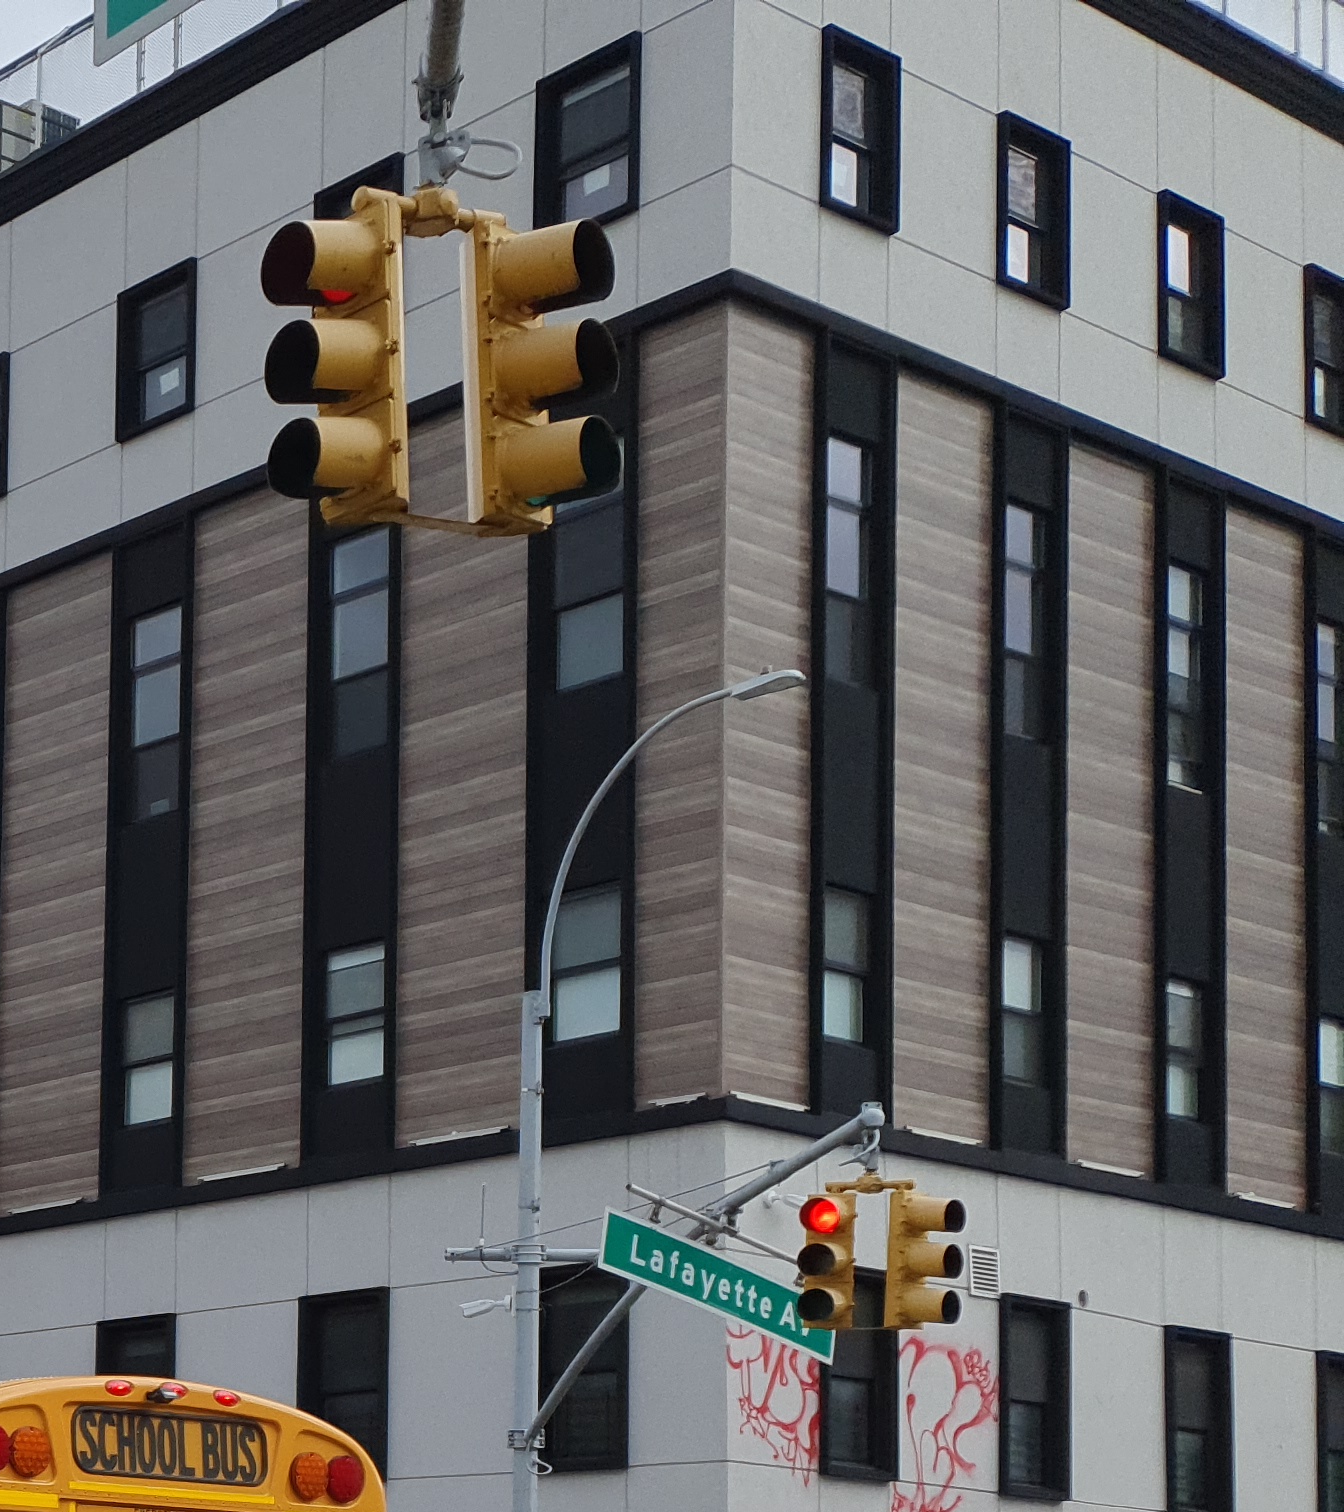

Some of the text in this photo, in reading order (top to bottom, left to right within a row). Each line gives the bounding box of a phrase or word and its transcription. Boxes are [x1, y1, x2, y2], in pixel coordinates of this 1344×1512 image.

[629, 1233, 774, 1319] Lafayette
[78, 1410, 257, 1483] SCHOOL BUS
